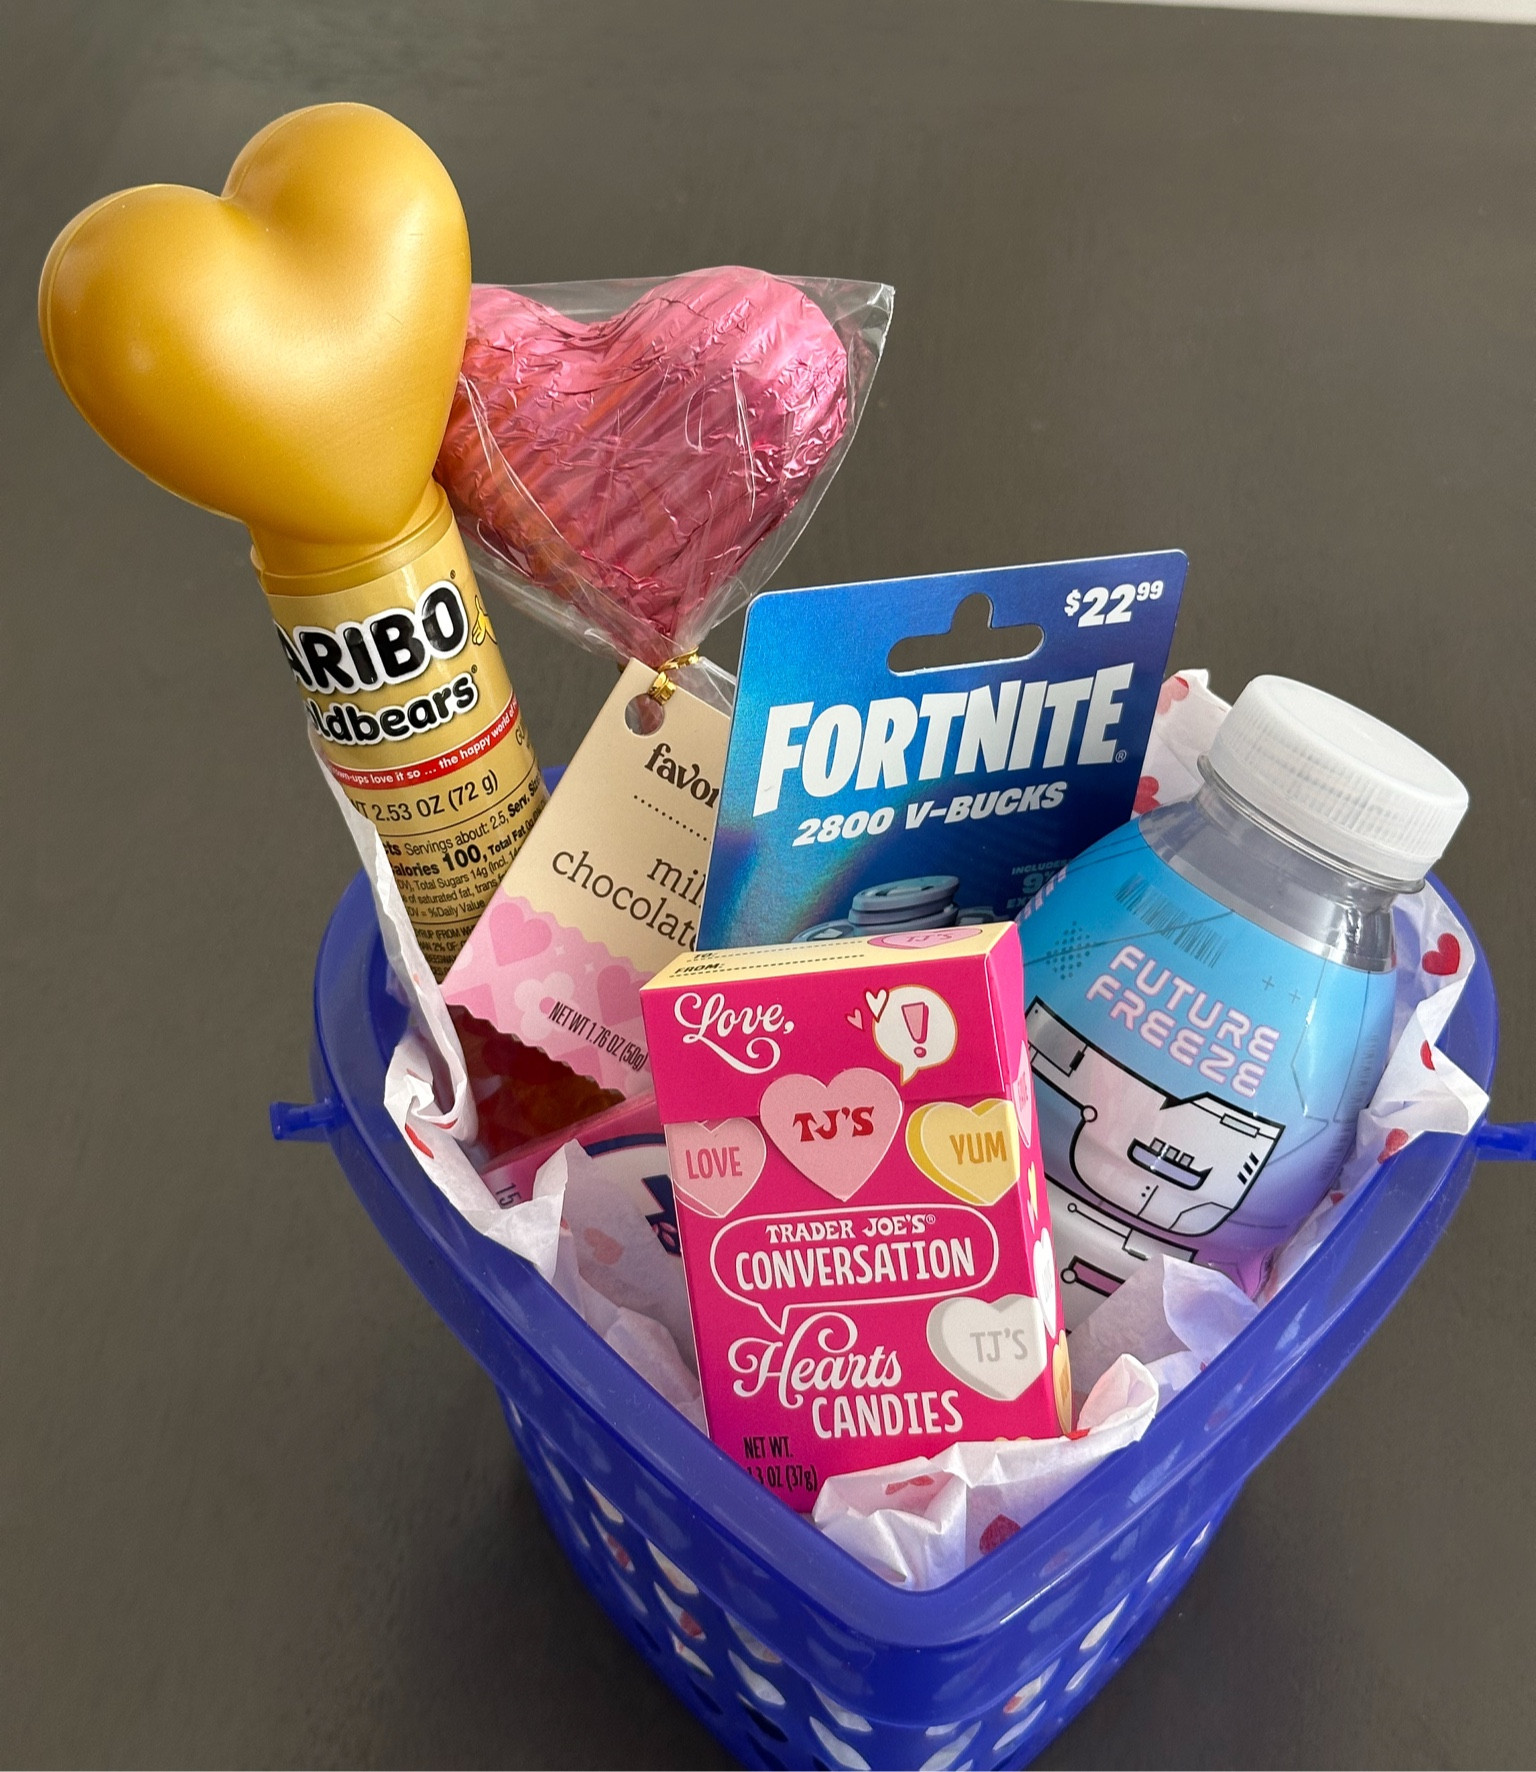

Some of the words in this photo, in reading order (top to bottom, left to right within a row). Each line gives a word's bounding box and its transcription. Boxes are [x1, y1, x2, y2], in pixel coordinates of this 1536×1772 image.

[370, 774, 393, 784] love
[395, 771, 404, 782] it
[407, 769, 420, 779] so
[439, 755, 459, 769] the
[459, 735, 491, 760] happy
[491, 713, 511, 738] world
[372, 802, 412, 821] 2.53
[416, 795, 445, 817] OZ
[448, 781, 479, 812] (72
[482, 769, 498, 795] g)
[792, 807, 895, 847] 2800
[906, 781, 1068, 830] V-BUCKS
[404, 838, 454, 856] Servings
[455, 823, 490, 846] about:
[490, 810, 509, 830] 2.5,
[507, 794, 530, 817] Serv.
[442, 844, 488, 871] 100,
[488, 835, 512, 856] Total
[511, 825, 526, 842] Fat
[408, 894, 417, 903] of
[418, 890, 459, 905] saturated
[459, 886, 475, 899] fat,
[474, 880, 498, 894] trans
[414, 880, 436, 891] Total
[436, 873, 470, 889] Sugars
[470, 867, 488, 880] 14g
[488, 857, 509, 875] (Incl.
[646, 857, 707, 909] mil
[428, 904, 459, 918] %Daily
[459, 898, 486, 913] Value
[674, 962, 725, 975] FROM:
[1108, 944, 1281, 1063] FUTURE
[548, 1001, 575, 1027] NET
[568, 1011, 591, 1036] WT
[585, 1022, 611, 1048] 1.76
[606, 1034, 626, 1057] OZ
[618, 1041, 649, 1072] (50g)
[674, 992, 795, 1074] Love,
[1085, 972, 1268, 1098] FREEZE
[792, 1105, 875, 1143] TJ'S
[949, 1131, 1007, 1165] YUM
[685, 1146, 743, 1179] LOVE
[766, 1218, 856, 1244] TRADER
[735, 1237, 975, 1291] CONVERSATION
[727, 1311, 902, 1409] Hearts
[970, 1328, 1028, 1363] TJ'S
[811, 1389, 963, 1439] CANDIES
[743, 1436, 766, 1459] NET
[768, 1436, 793, 1458] WT.
[767, 1465, 783, 1488] OZ
[785, 1464, 818, 1492] (37g)
